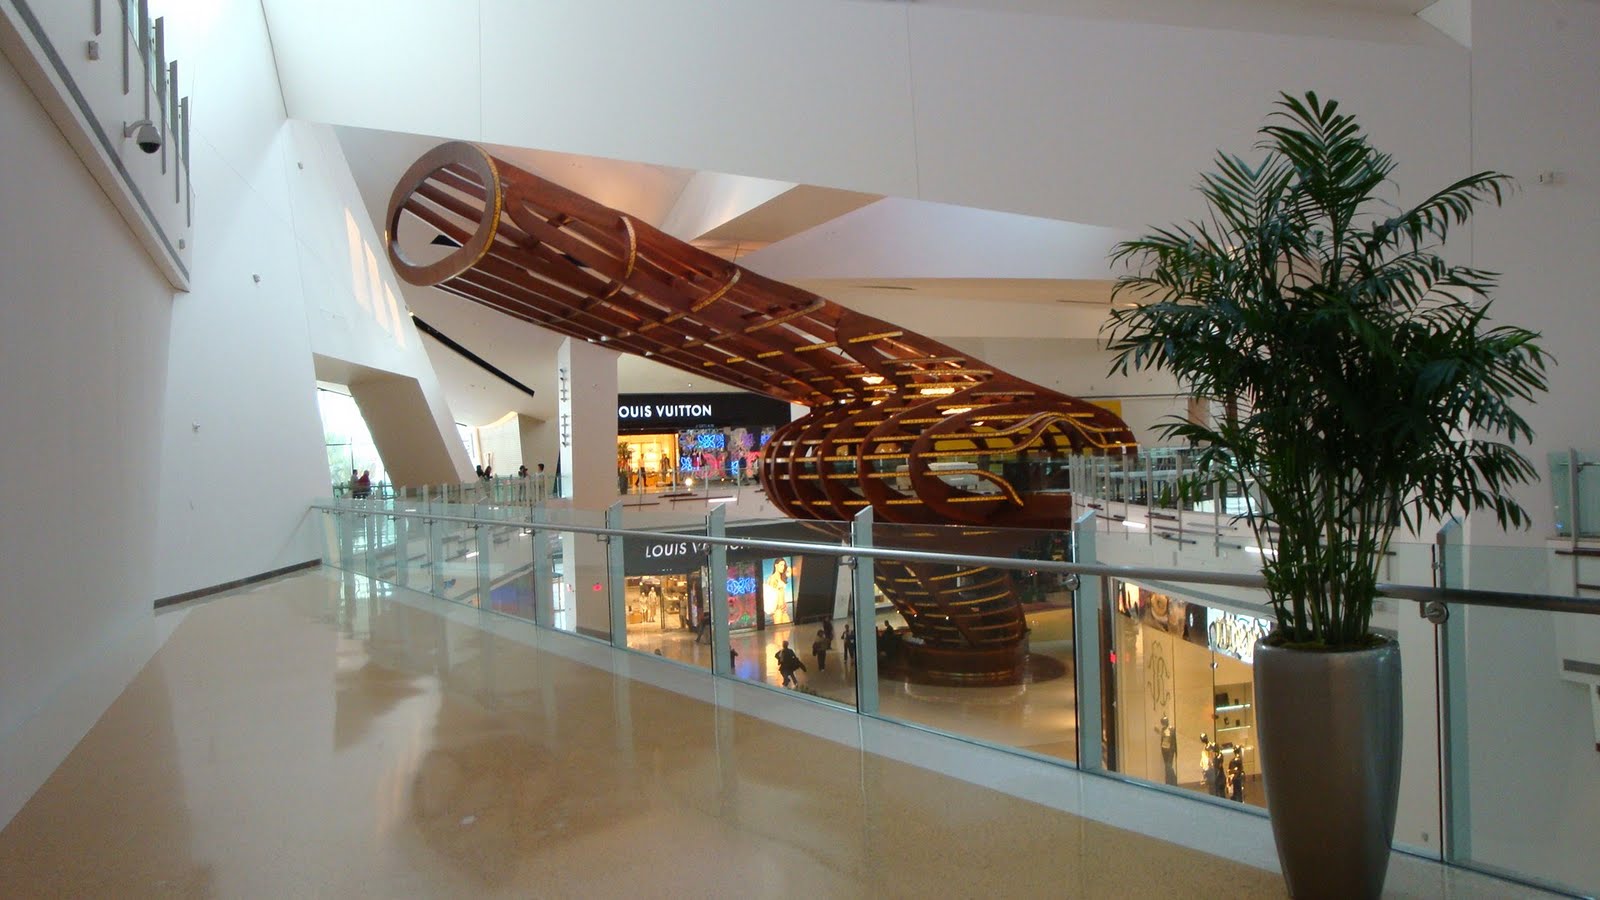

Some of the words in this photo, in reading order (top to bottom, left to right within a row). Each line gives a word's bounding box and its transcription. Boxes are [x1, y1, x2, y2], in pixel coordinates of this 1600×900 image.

[618, 405, 652, 418] OUIS
[656, 404, 712, 417] VUITTON
[646, 542, 687, 558] LOUIS
